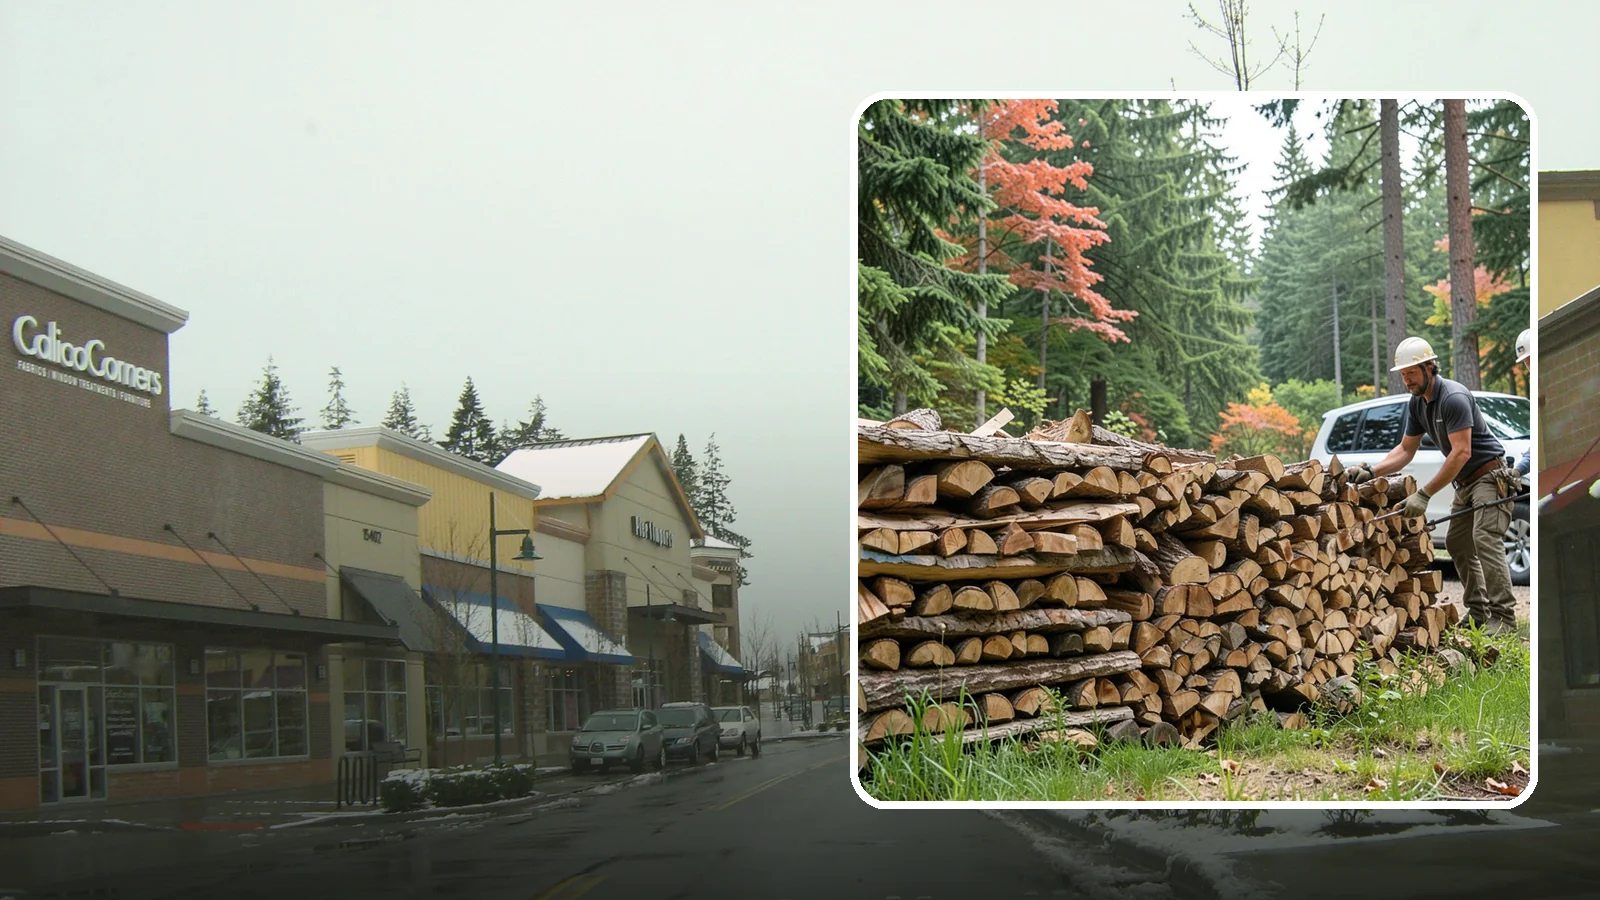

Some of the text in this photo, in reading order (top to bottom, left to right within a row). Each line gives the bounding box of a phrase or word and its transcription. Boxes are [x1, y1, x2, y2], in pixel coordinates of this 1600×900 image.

[16, 360, 151, 408] FABRICS WINDOW TREATMENTS FURNITURE
